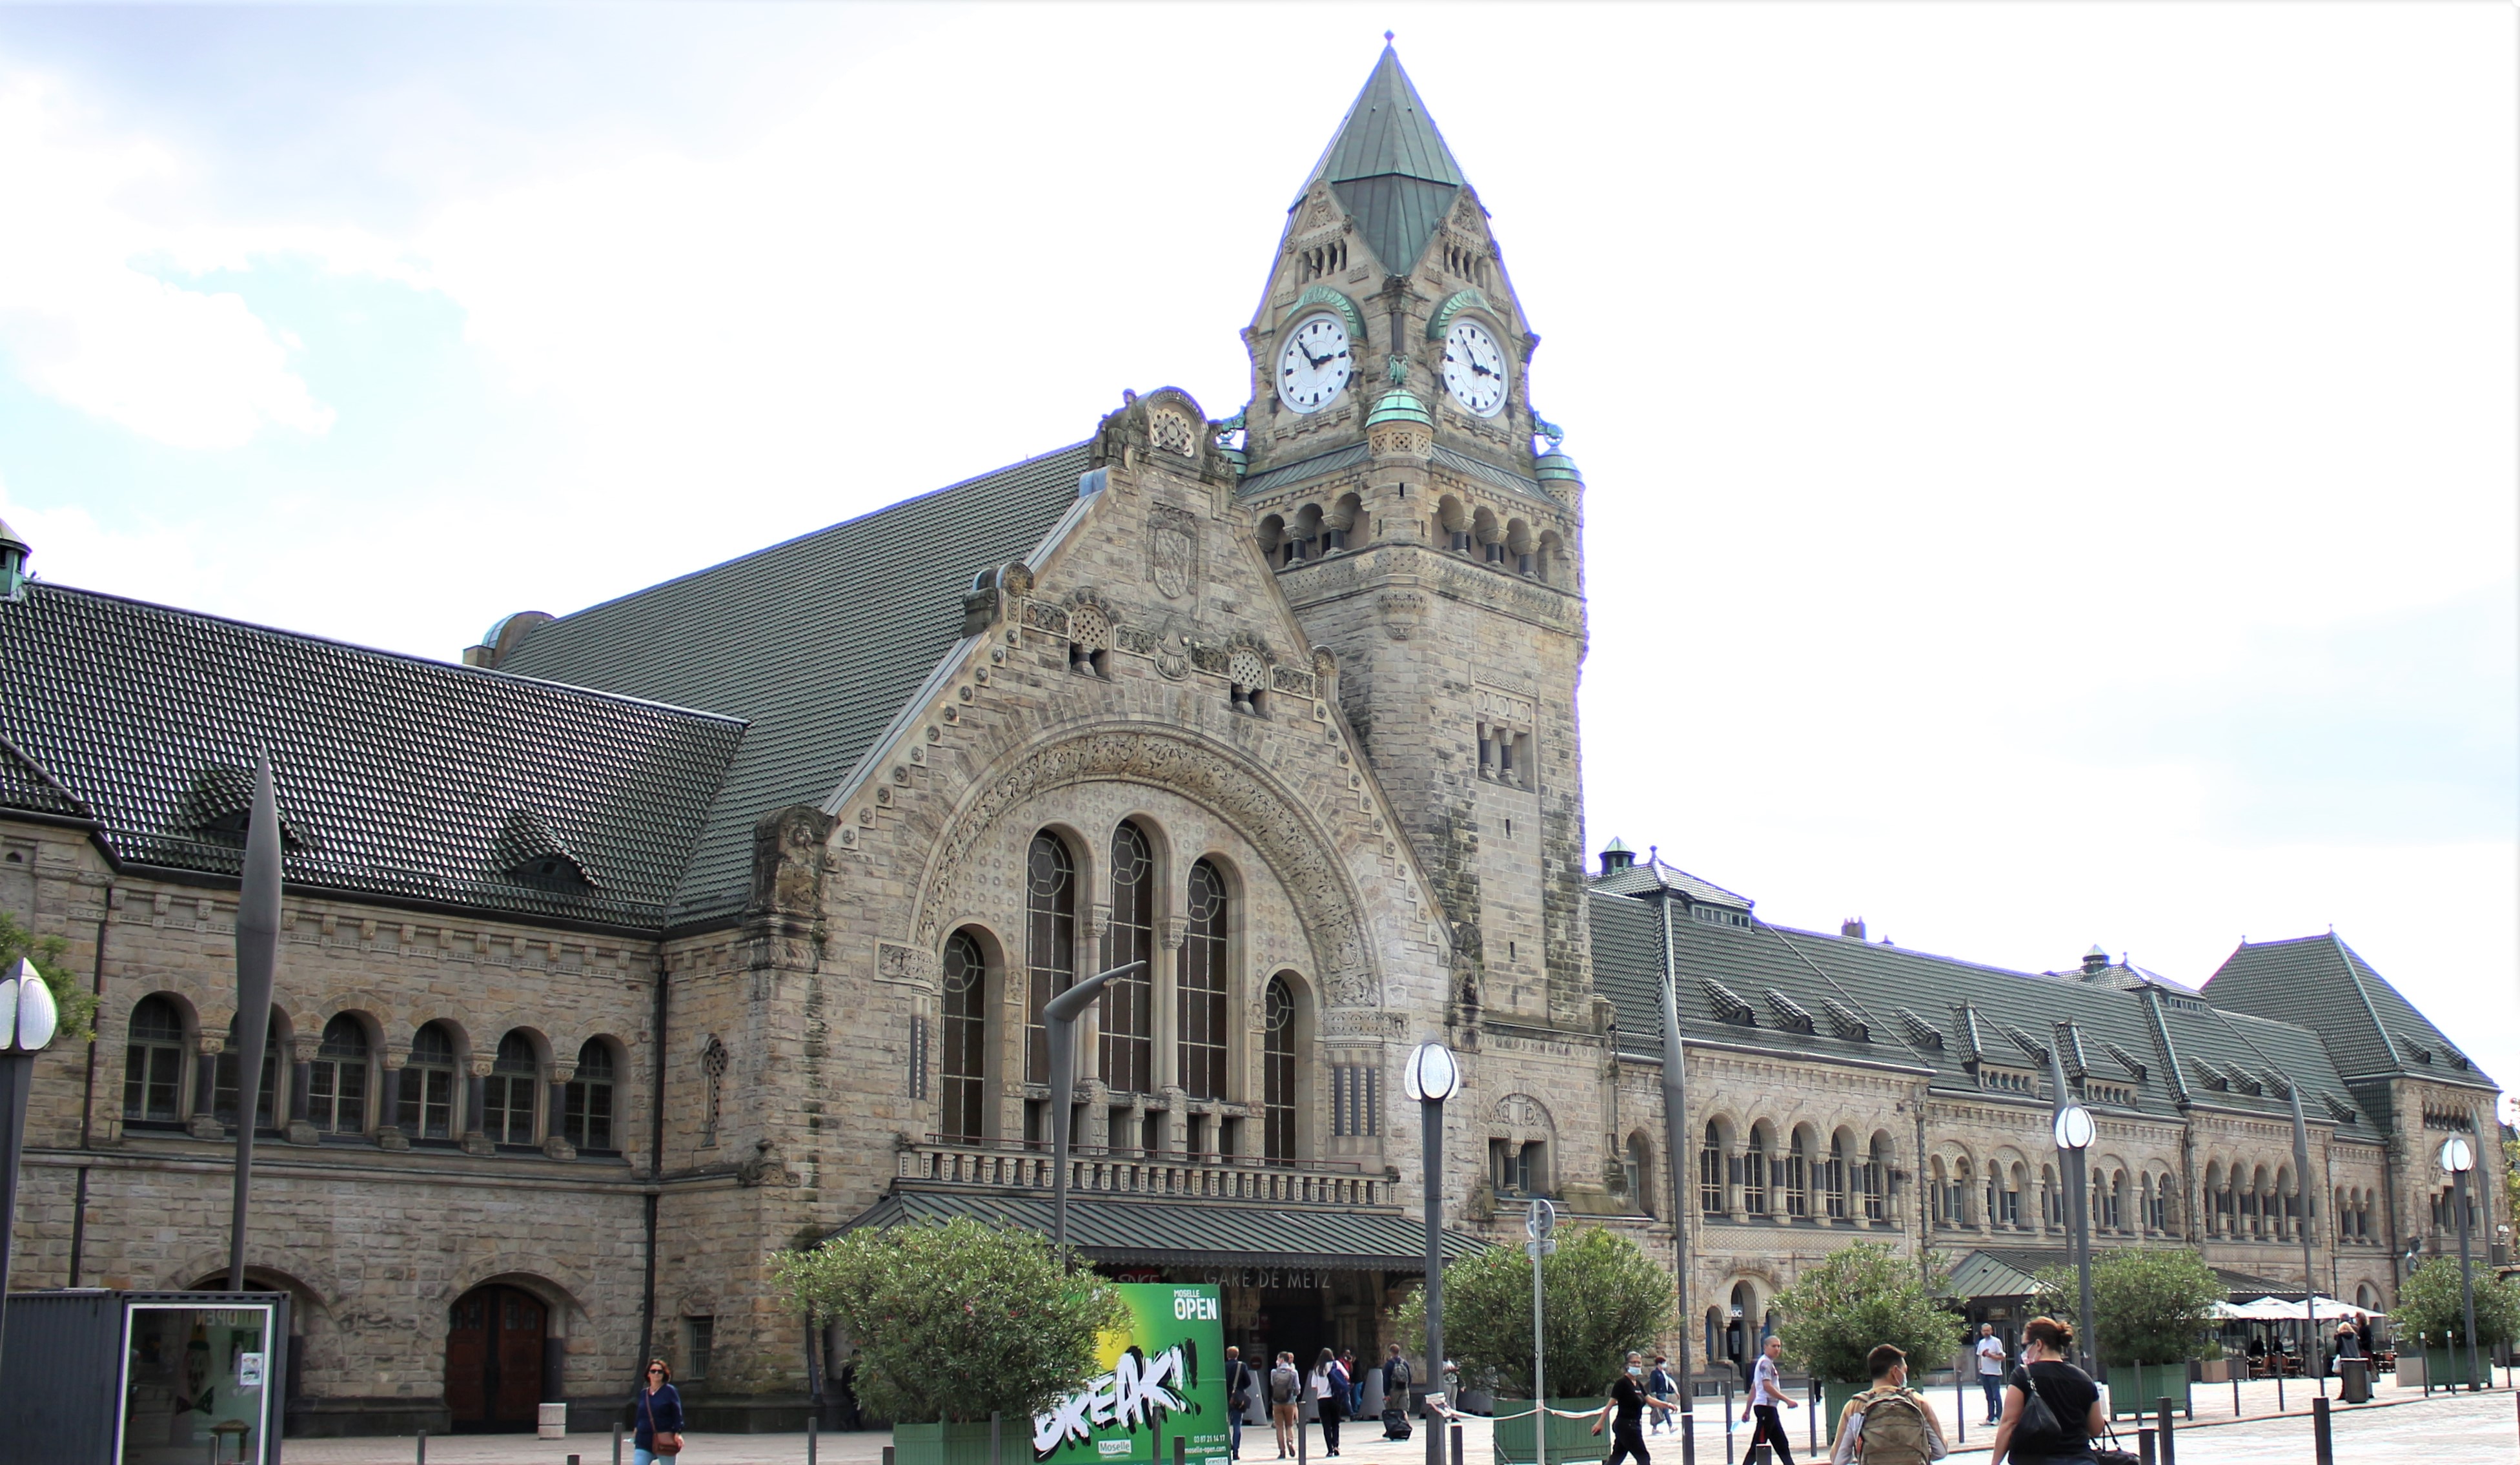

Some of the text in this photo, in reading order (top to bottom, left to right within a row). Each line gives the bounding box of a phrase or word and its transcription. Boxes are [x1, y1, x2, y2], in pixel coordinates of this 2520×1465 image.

[1204, 1269, 1330, 1288] GARE DE METZ
[1174, 1289, 1200, 1298] MOSELLE
[1174, 1298, 1217, 1320] OPEN
[1194, 1435, 1199, 1444] 03
[1100, 1442, 1130, 1452] Moselle
